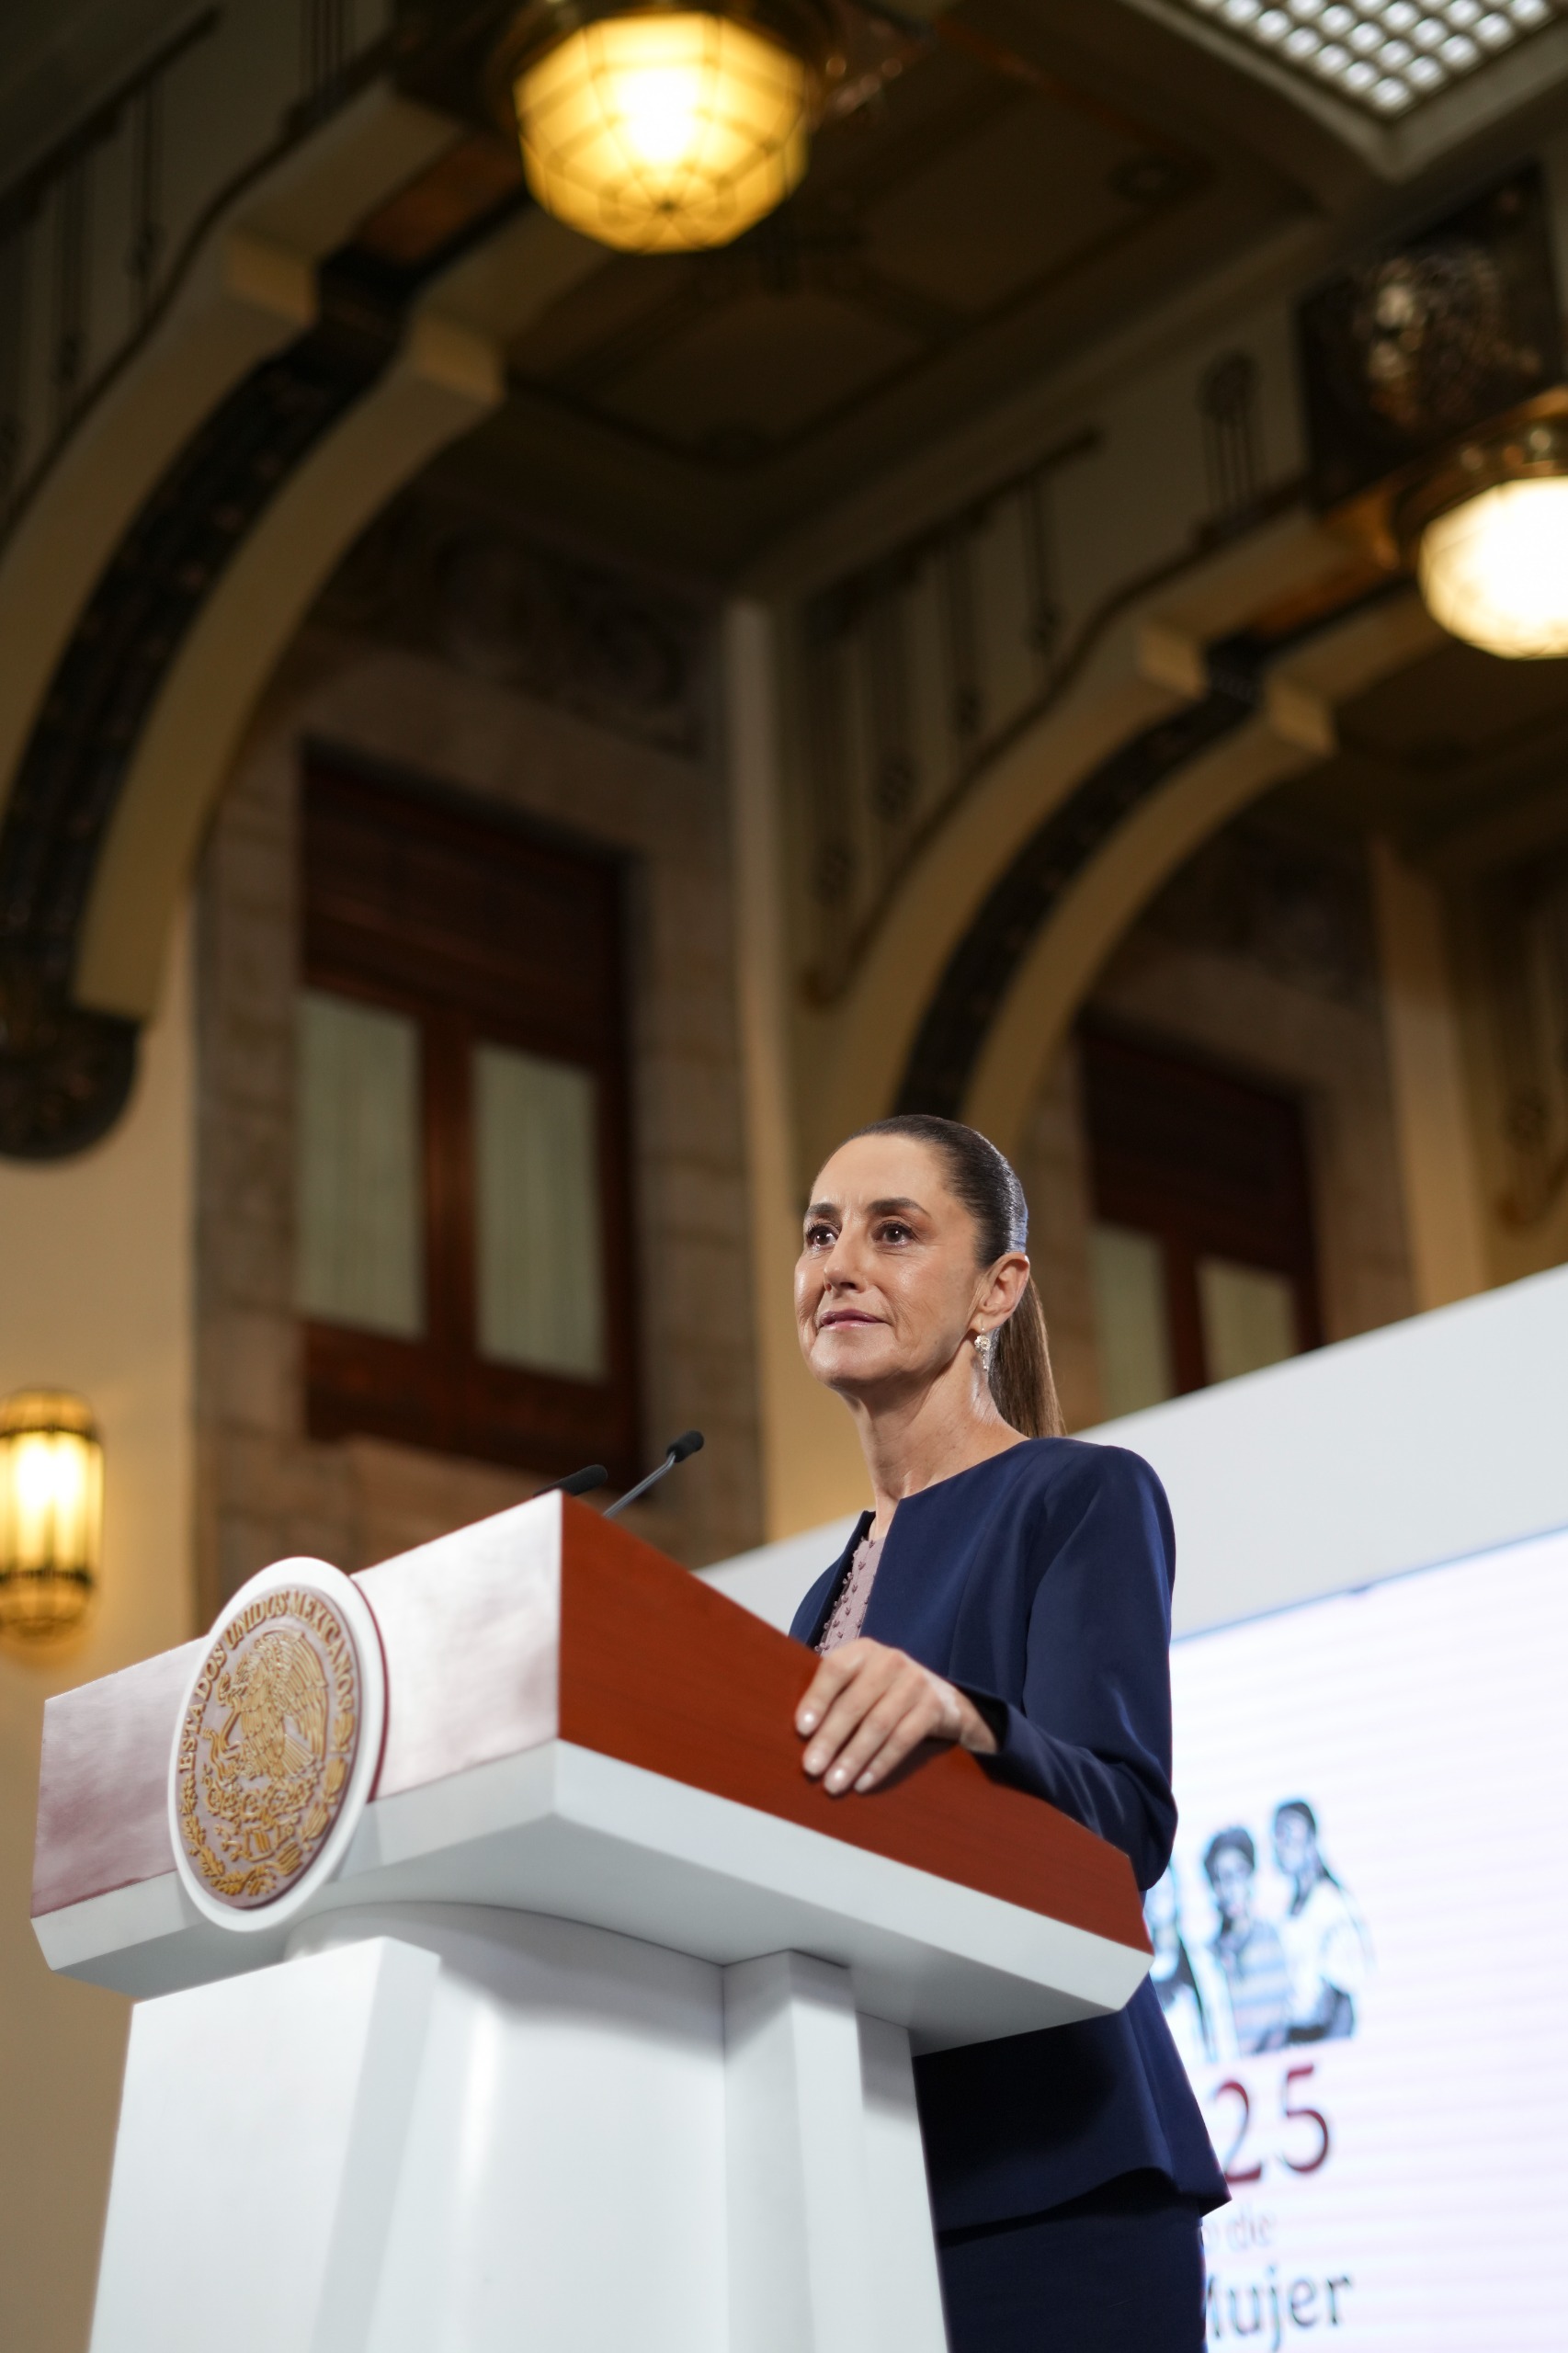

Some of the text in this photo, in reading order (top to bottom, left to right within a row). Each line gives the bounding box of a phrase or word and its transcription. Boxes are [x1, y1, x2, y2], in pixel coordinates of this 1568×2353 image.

[179, 1590, 355, 1774] ESTADOS UNIDOS MEXICANOS
